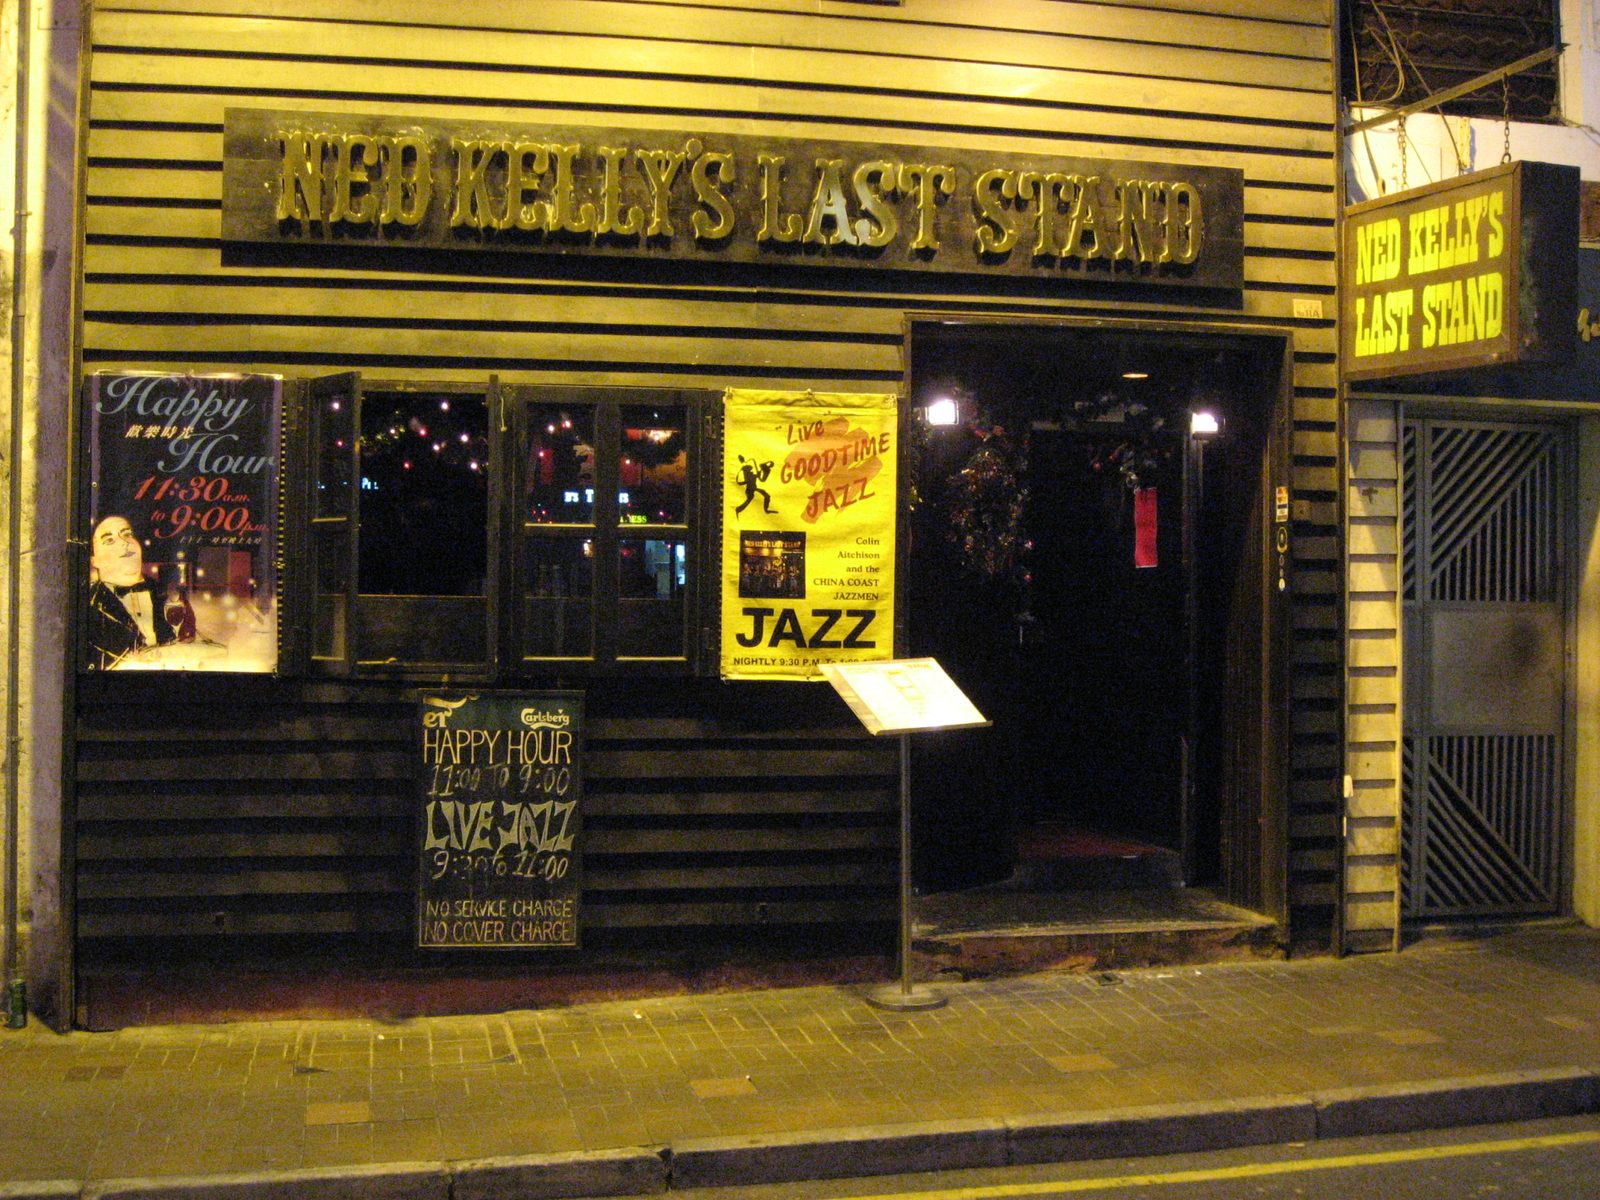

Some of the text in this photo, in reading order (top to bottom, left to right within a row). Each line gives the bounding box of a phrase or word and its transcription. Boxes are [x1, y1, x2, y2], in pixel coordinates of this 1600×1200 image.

[276, 130, 1202, 264] NED KELLY'S LAST STAND
[1355, 190, 1504, 285] NED KELLY'S
[1355, 289, 1414, 358] LAST
[1422, 271, 1504, 349] STAND
[95, 376, 255, 431] Happy
[787, 420, 824, 445] Live
[157, 433, 276, 475] Hour
[805, 477, 876, 518] JAZZ
[855, 537, 880, 546] Colin
[837, 551, 880, 560] Aitchison
[846, 565, 880, 573] and the
[813, 578, 879, 587] CHINA COAST
[833, 592, 879, 601] JAZZMEN
[735, 607, 876, 649] JAZZ
[733, 657, 776, 666] NIGHTLY
[779, 659, 800, 667] 9:30
[521, 708, 570, 729] Carlsberg
[424, 729, 573, 765] HAPPY HOUR
[425, 800, 577, 853] LIVE JAZZ
[425, 900, 573, 918] NO SERVICE CHARGE
[424, 920, 572, 942] NO COVER CHARGE
